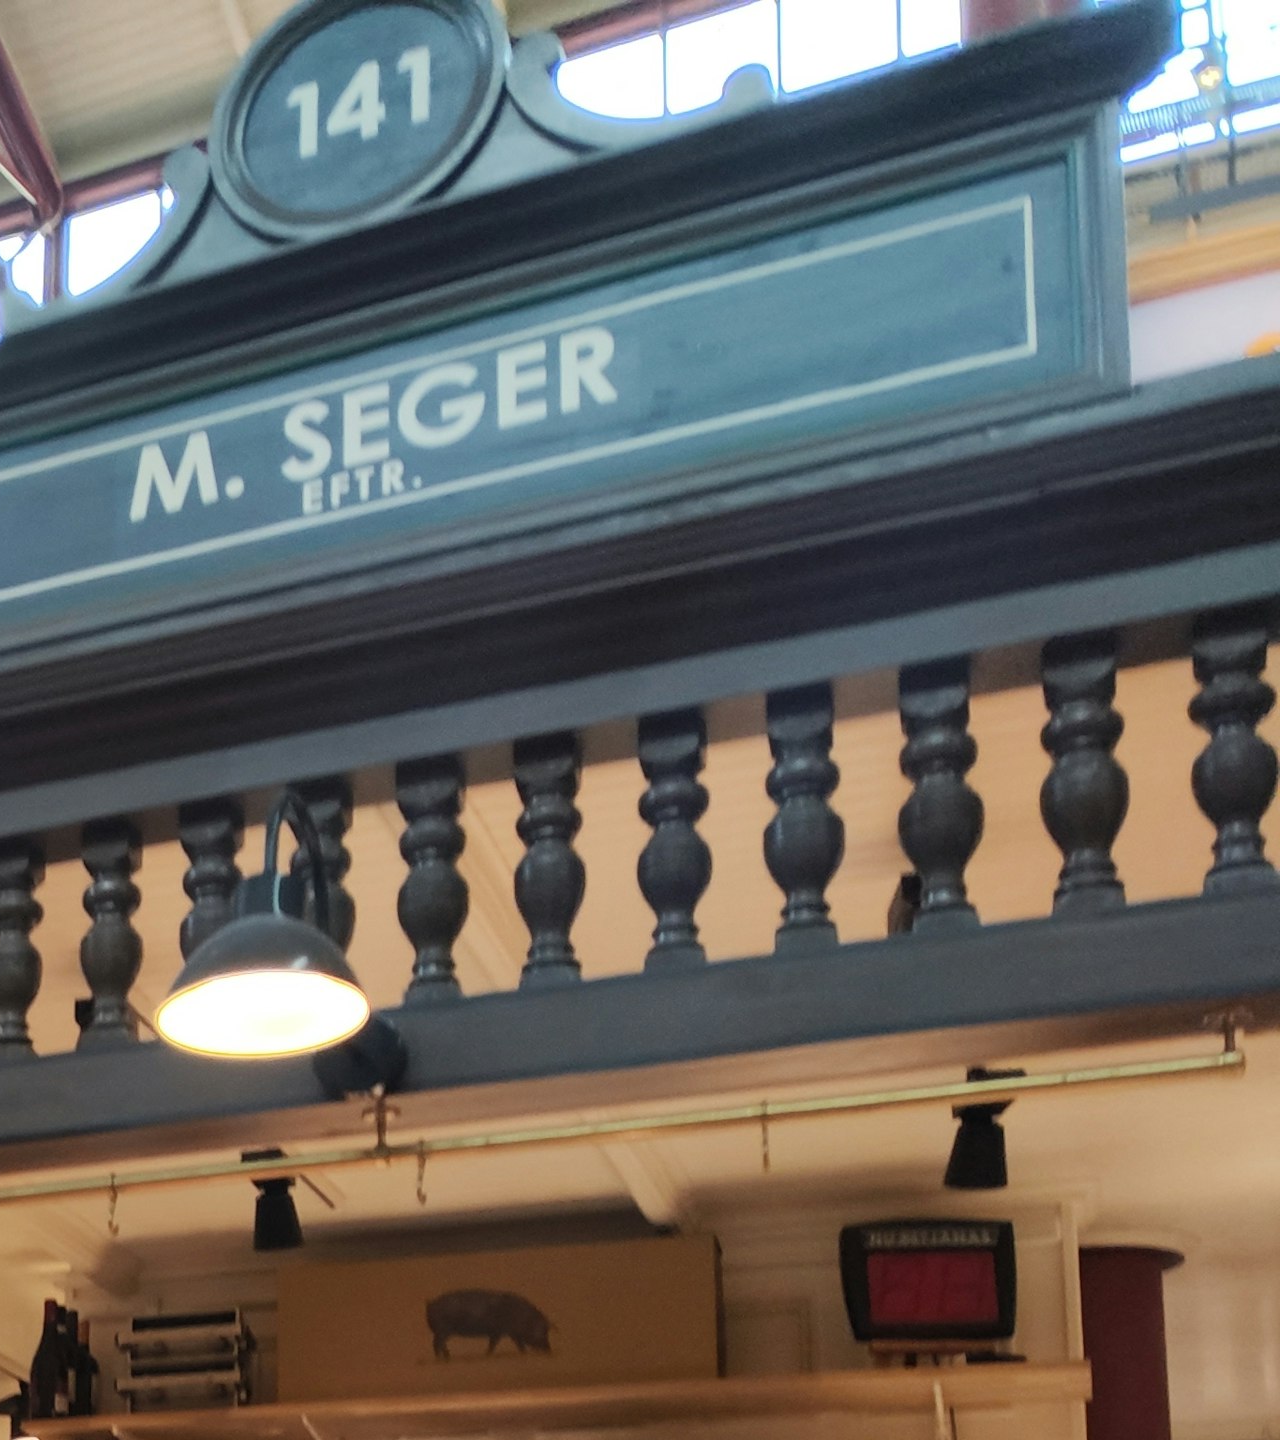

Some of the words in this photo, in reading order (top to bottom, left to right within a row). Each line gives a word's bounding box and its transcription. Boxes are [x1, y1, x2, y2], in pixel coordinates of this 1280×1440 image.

[285, 47, 433, 158] 141
[129, 431, 244, 523] M.
[281, 327, 619, 481] SEGER
[301, 460, 423, 515] EFTR.
